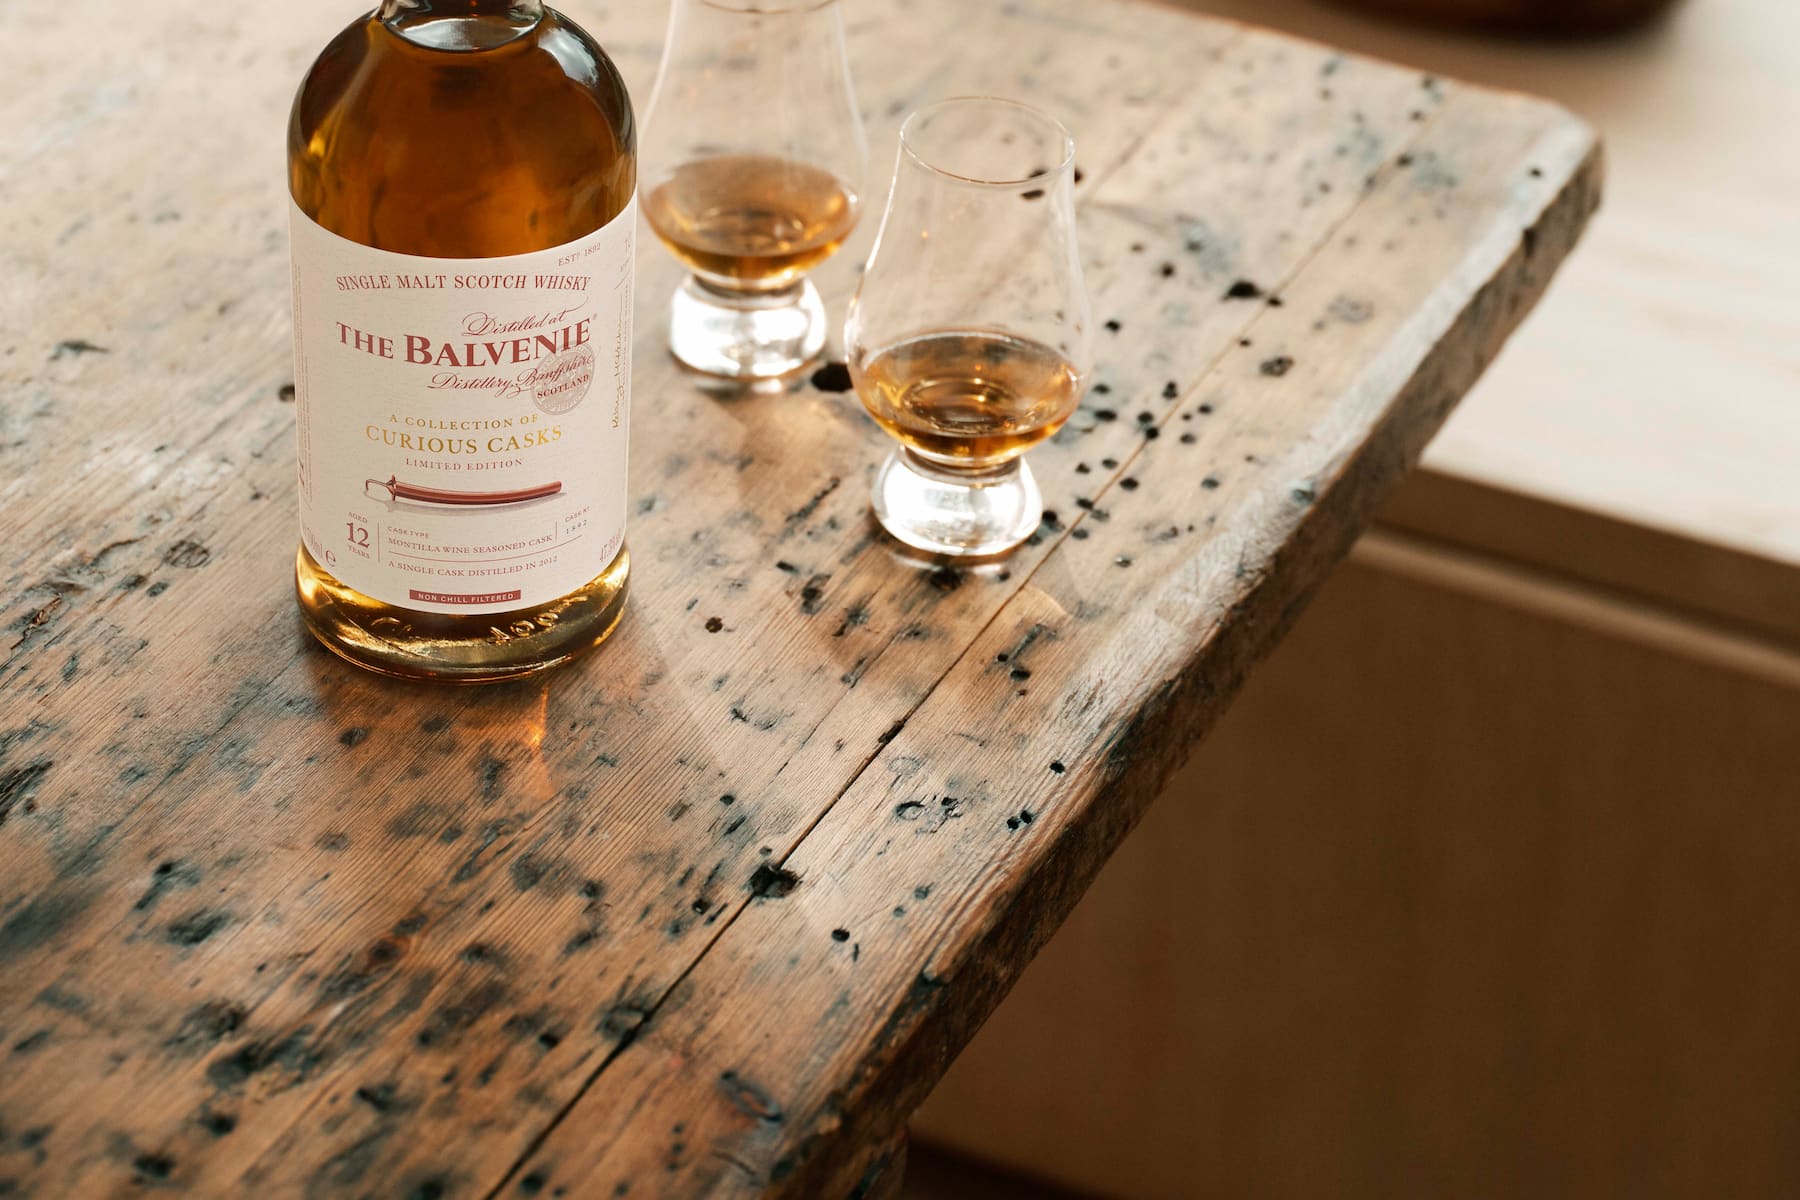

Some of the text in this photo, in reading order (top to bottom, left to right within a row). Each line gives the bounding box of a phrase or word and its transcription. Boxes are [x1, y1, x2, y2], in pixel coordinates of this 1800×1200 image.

[336, 274, 591, 291] SINGLE MALT SCOTCH WHISKY
[461, 311, 550, 336] Distilled
[336, 318, 591, 367] THE BALVENIE
[537, 373, 589, 399] SCOTLAND
[390, 413, 539, 431] A COLLECTION OF
[366, 424, 562, 455] CURIOUS CASKS
[406, 457, 523, 471] LIMITED EDITION
[348, 511, 368, 524] AGED
[346, 521, 370, 548] 12
[410, 530, 430, 539] TYPE
[348, 544, 370, 559] YEARS
[388, 534, 553, 555] MONTILLA WINE SEASONED CASK
[388, 560, 395, 568] A
[397, 562, 435, 575] SINGLE
[437, 569, 465, 577] CASK
[468, 565, 523, 577] DISTILLED
[526, 561, 536, 570] IN
[418, 592, 515, 604] NON CHILL FILTERED
